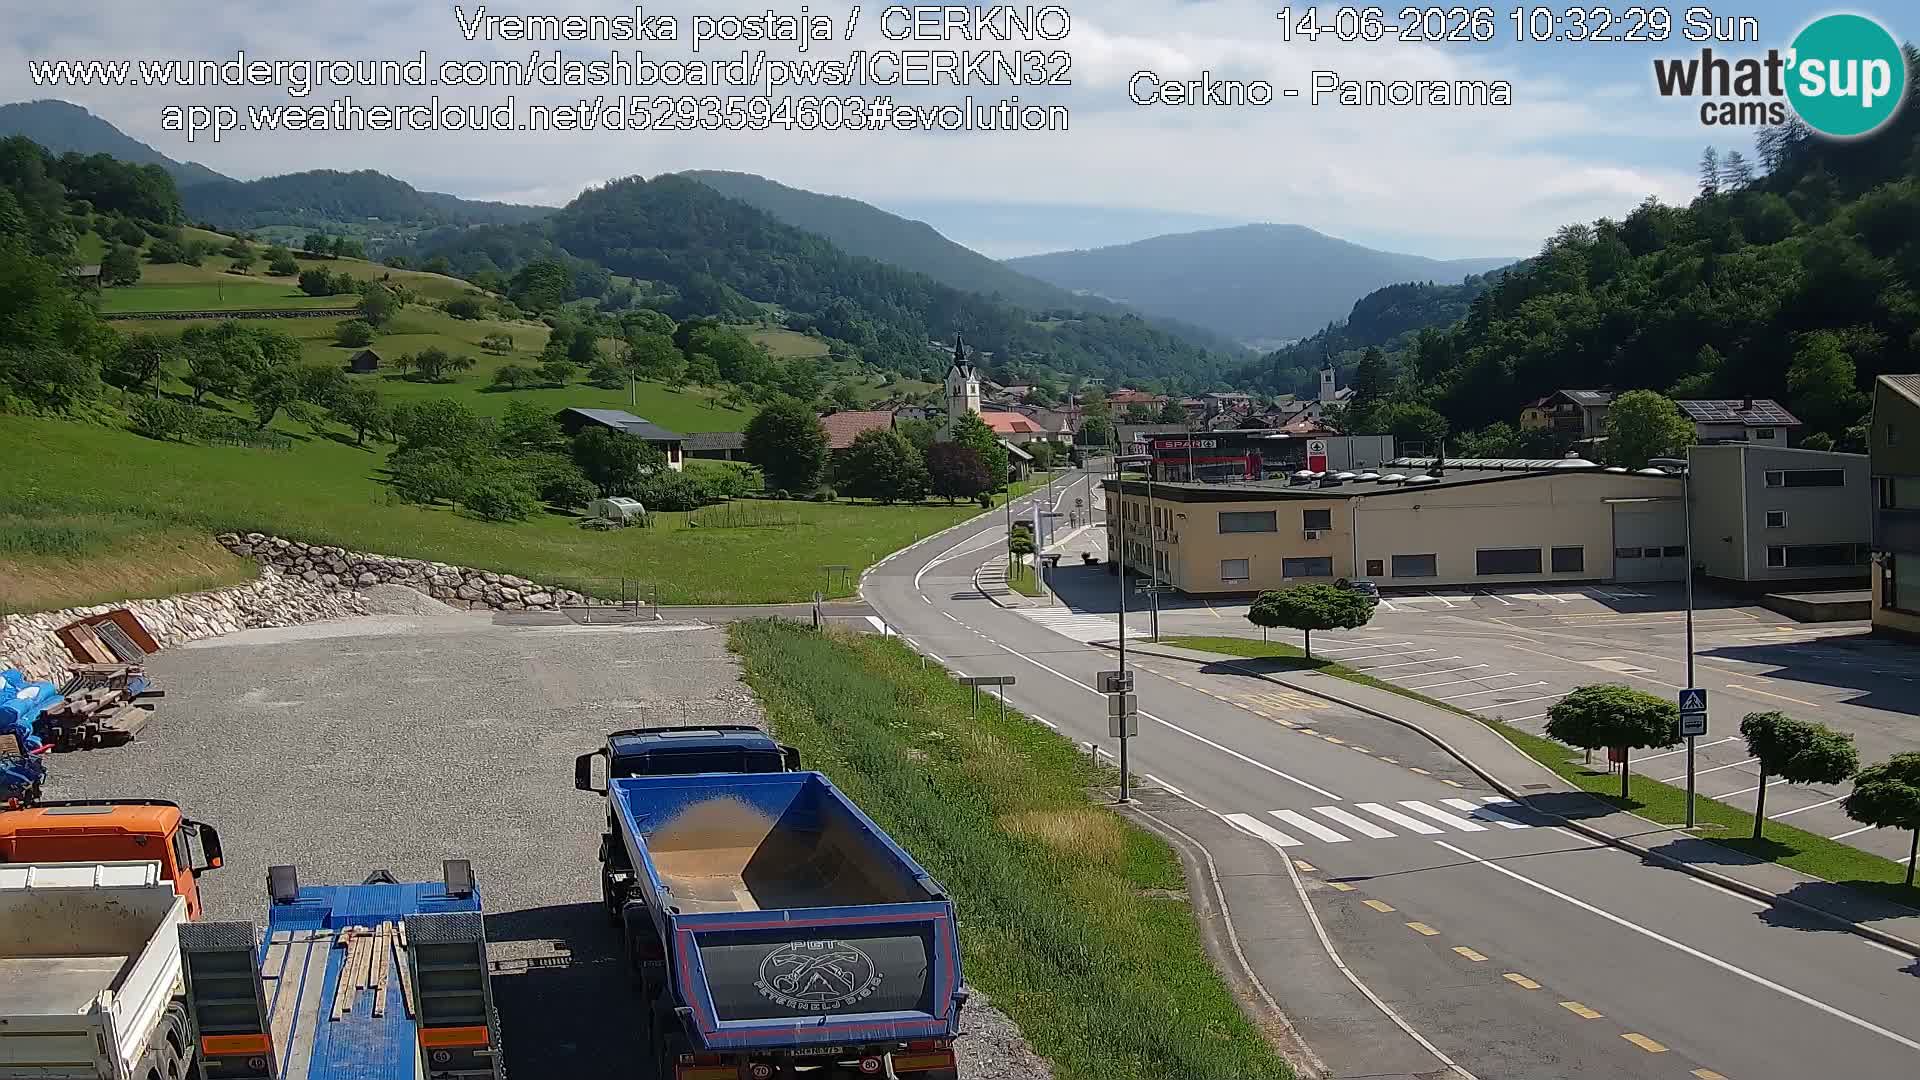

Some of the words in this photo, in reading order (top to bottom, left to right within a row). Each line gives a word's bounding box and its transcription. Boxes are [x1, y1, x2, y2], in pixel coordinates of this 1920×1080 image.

[791, 940, 838, 951] PGT
[865, 1060, 877, 1069] 80
[755, 1066, 769, 1076] 70
